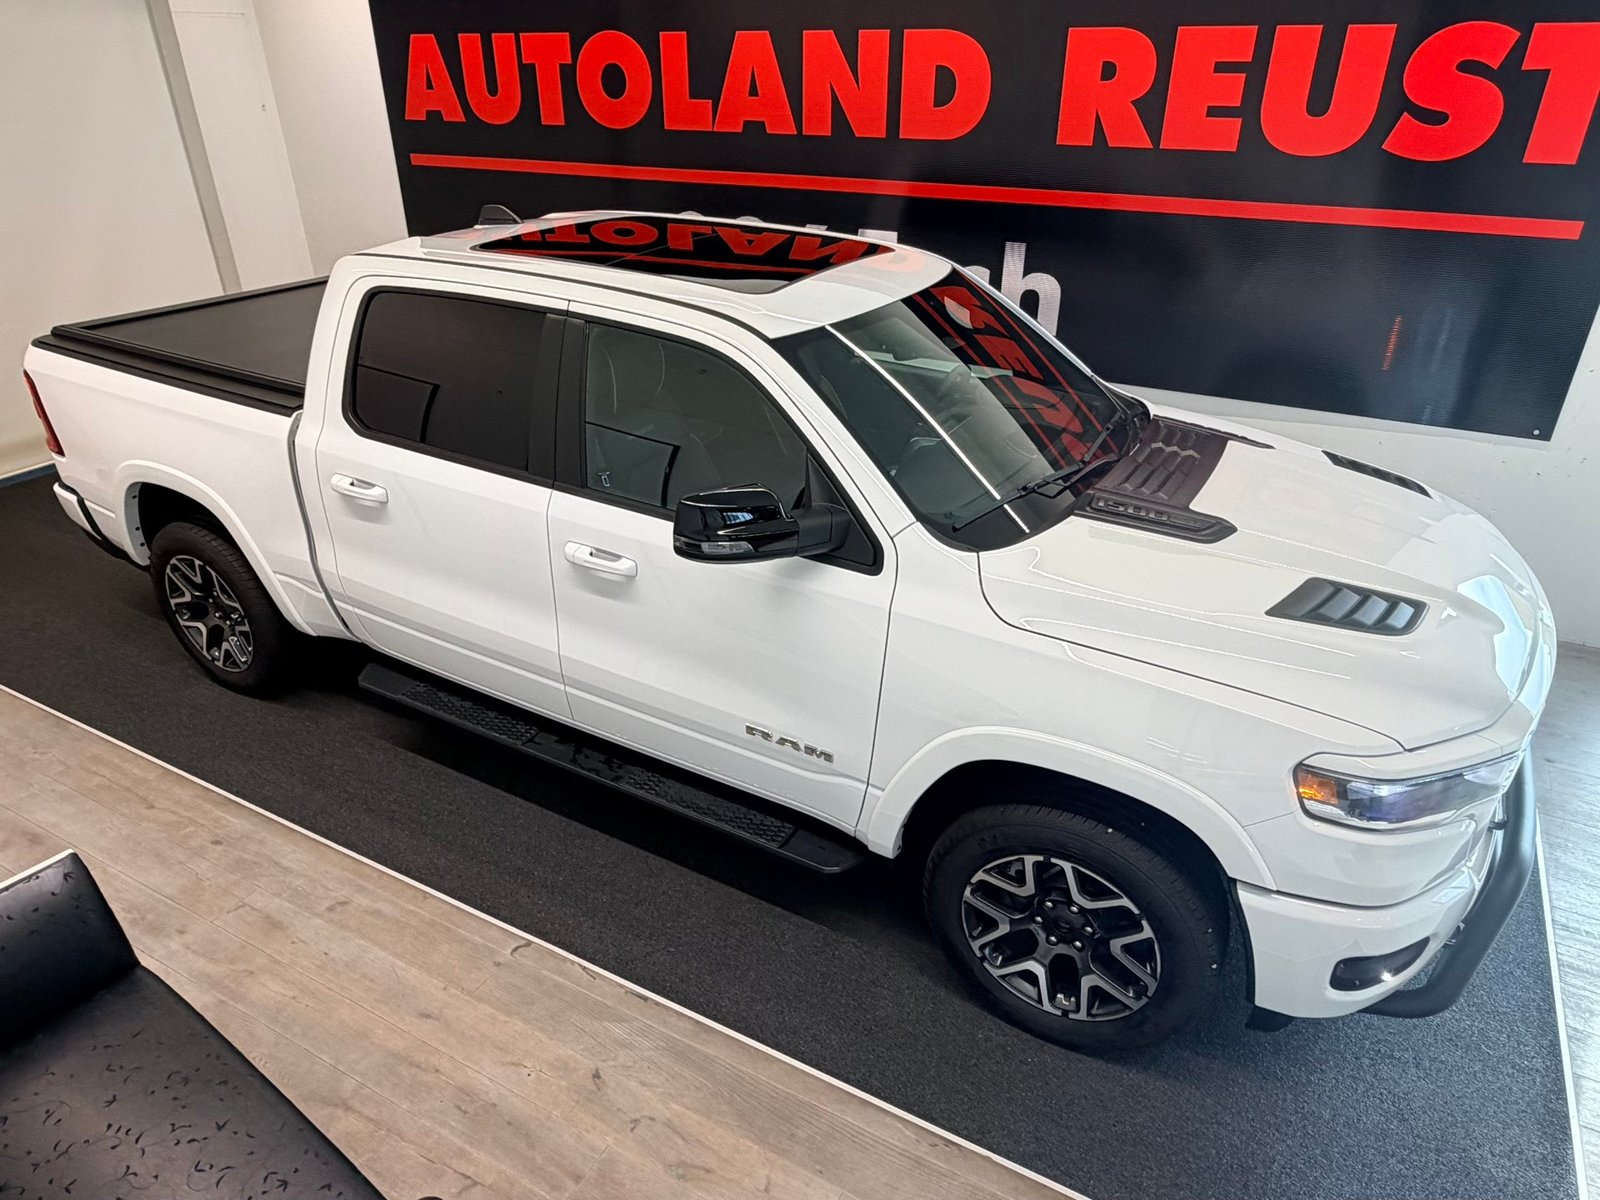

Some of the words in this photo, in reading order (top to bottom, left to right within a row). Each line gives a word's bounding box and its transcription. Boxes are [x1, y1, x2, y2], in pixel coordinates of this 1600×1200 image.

[405, 29, 992, 140] AUTOLAND
[1056, 20, 1600, 165] REUST
[1096, 498, 1169, 521] 1500
[745, 722, 834, 764] RAM
